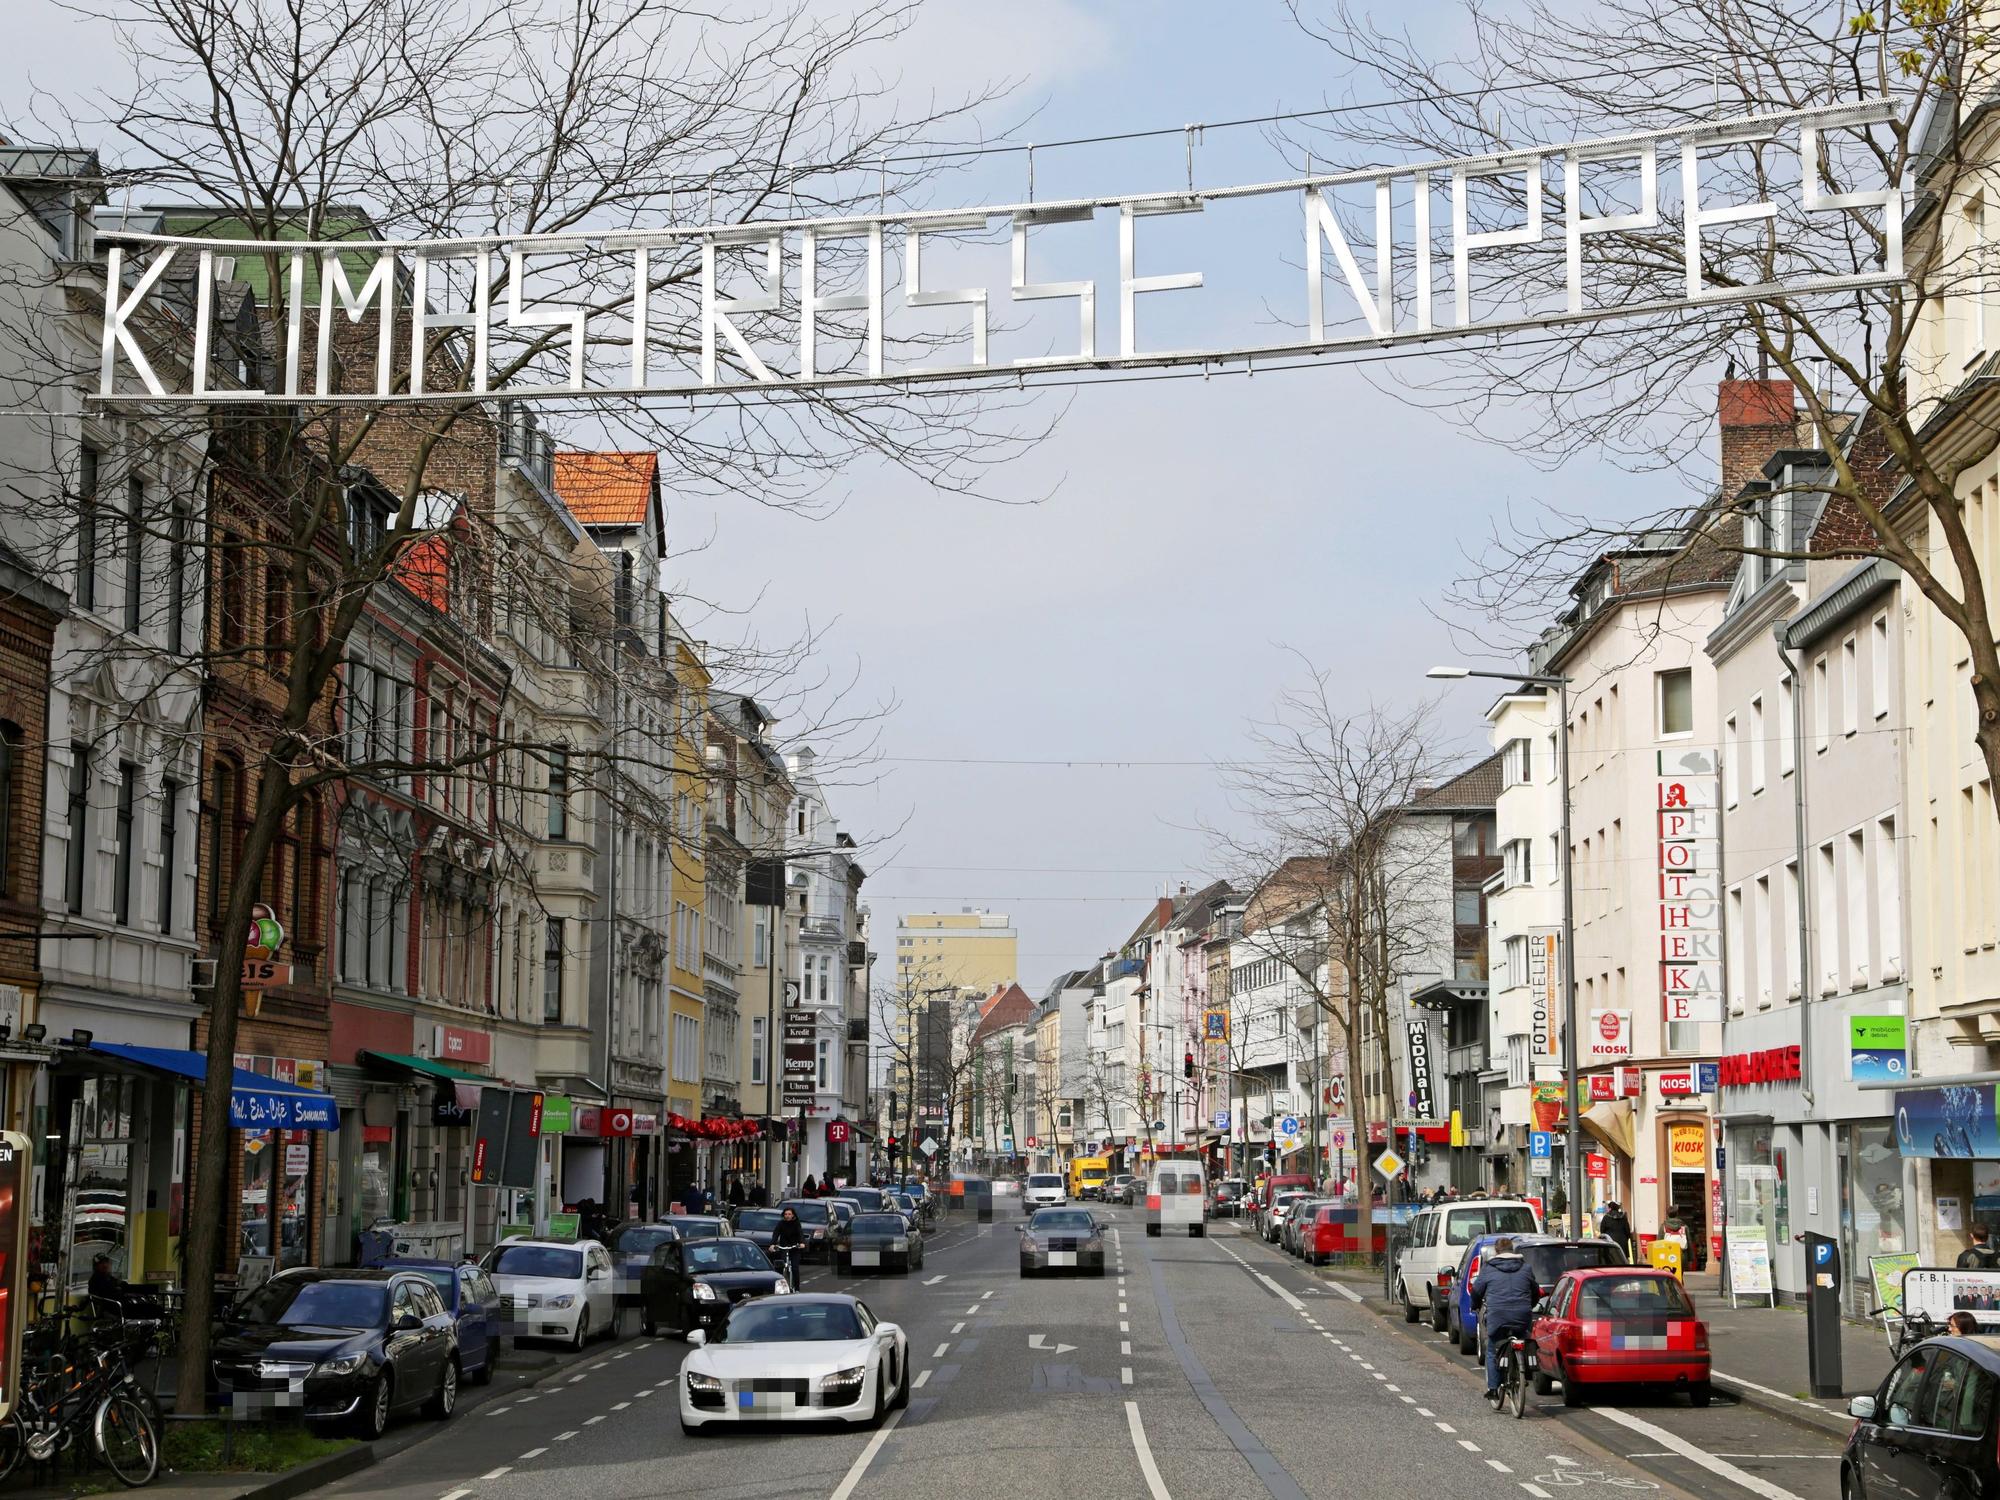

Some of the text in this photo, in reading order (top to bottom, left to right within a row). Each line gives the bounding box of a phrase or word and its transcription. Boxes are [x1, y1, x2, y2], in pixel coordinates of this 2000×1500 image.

[101, 102, 1905, 397] KLIMASTRASSE NIPPES
[1665, 783, 1690, 1019] APOTHEKE
[1531, 935, 1547, 1055] FOTOATELIER
[790, 1014, 812, 1022] Pfand-
[790, 1028, 810, 1036] Kredit
[1592, 1045, 1628, 1054] KIOSK
[785, 1058, 815, 1070] Kemp
[784, 1096, 814, 1105] Schmuck
[438, 1101, 466, 1118] sky
[832, 1125, 844, 1139] T
[1534, 1135, 1546, 1152] P
[1673, 1140, 1705, 1153] KIOSK
[1816, 1245, 1828, 1261] P
